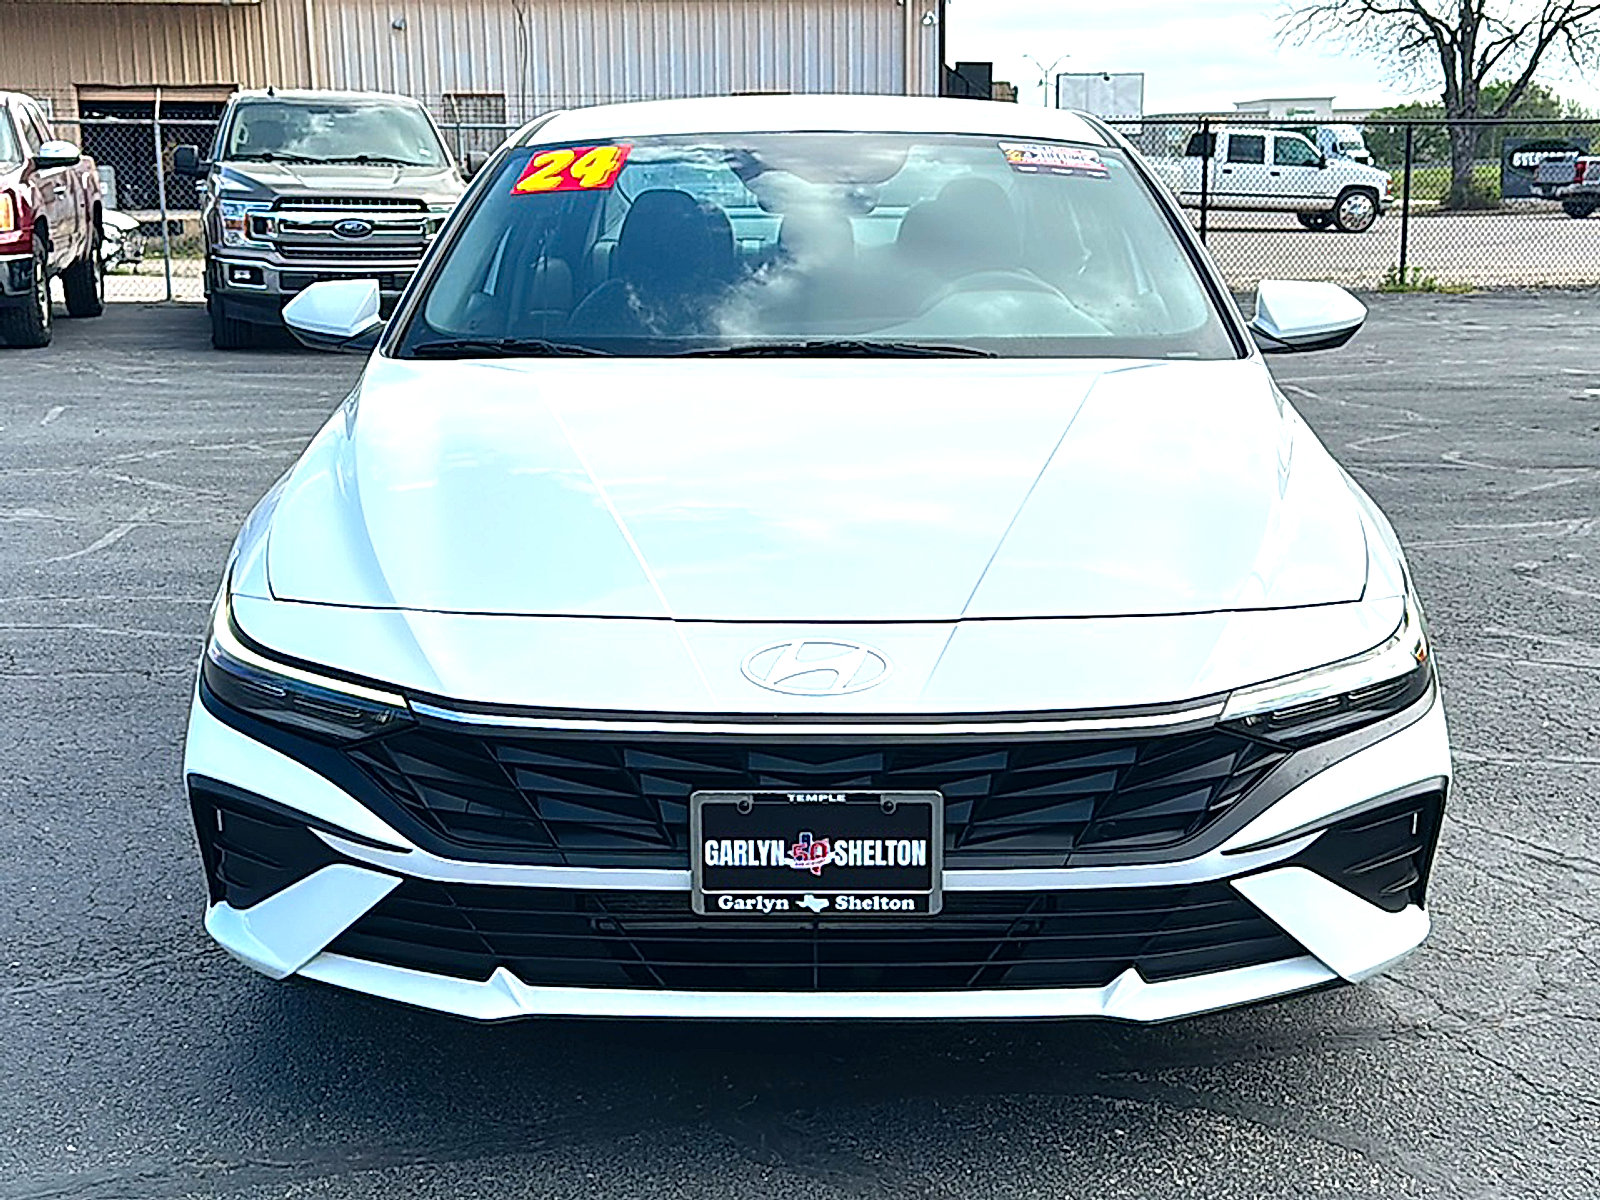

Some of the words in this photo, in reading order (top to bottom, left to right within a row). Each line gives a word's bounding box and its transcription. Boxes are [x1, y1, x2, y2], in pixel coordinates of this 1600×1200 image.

[516, 146, 621, 191] 24
[787, 794, 847, 803] TEMPLE
[704, 839, 785, 866] GARLYN
[834, 839, 927, 866] SHELTON
[718, 895, 790, 914] Garlyn
[834, 895, 916, 911] Shelton
